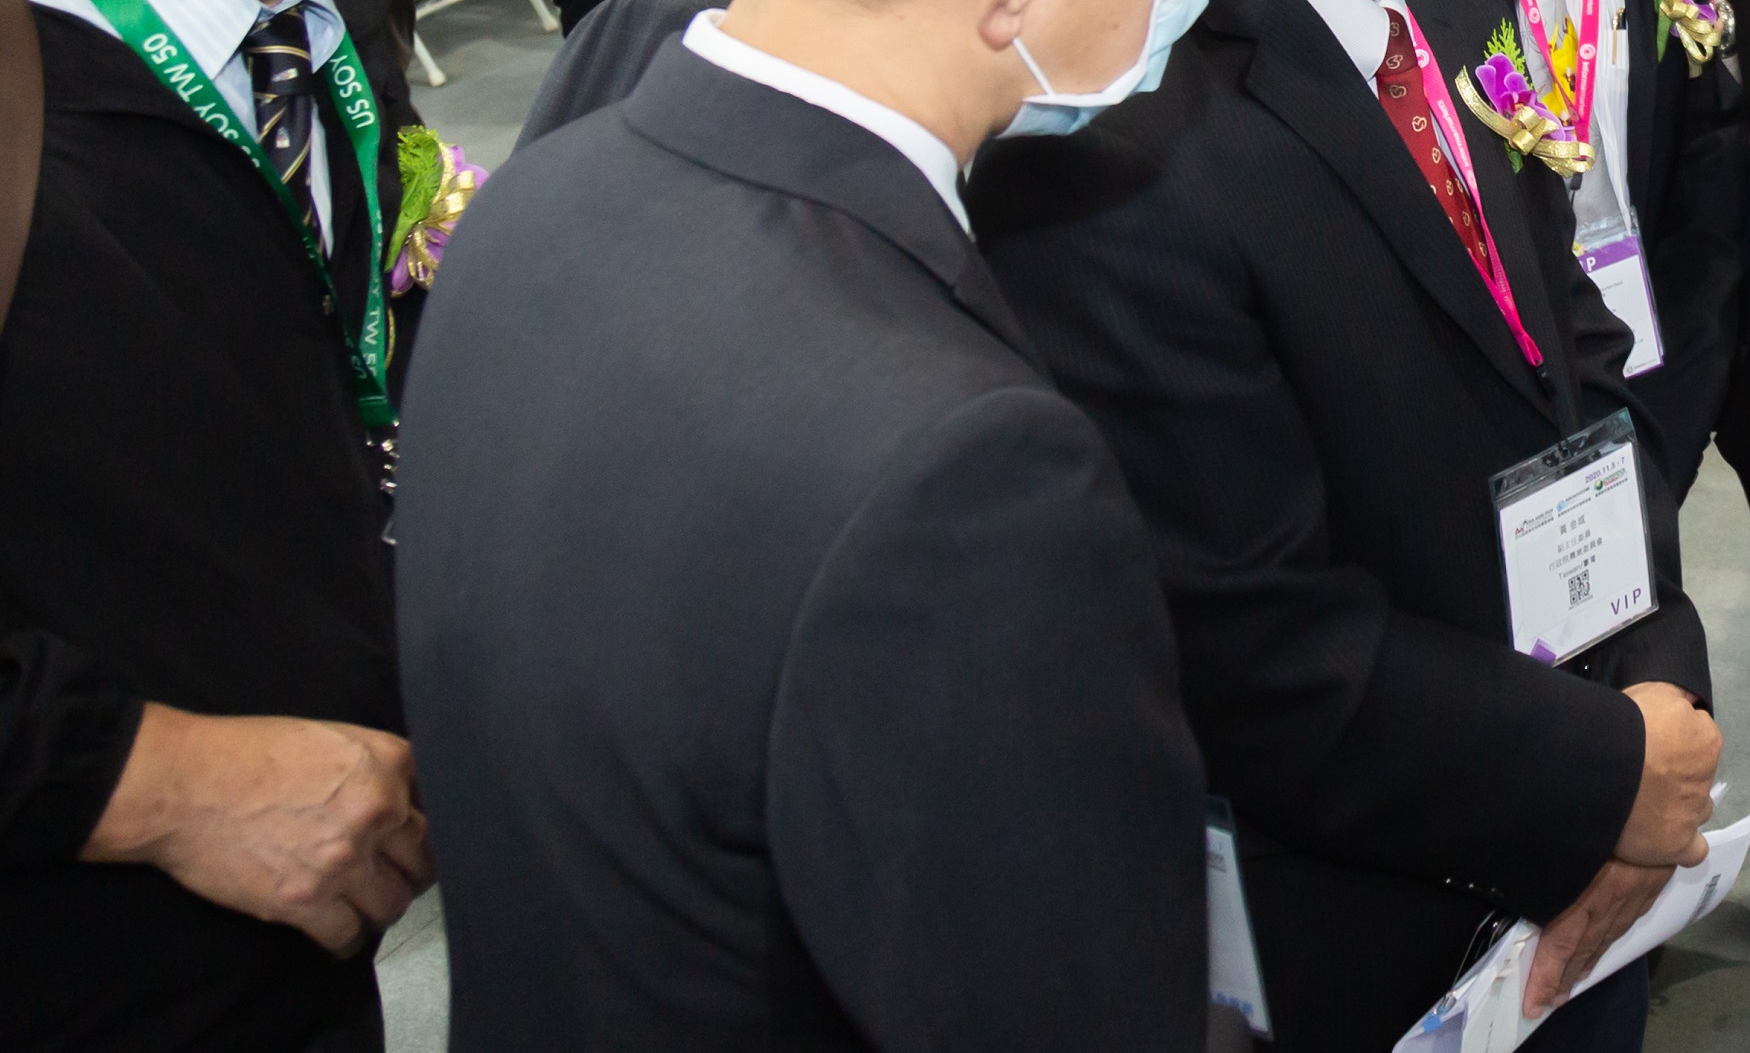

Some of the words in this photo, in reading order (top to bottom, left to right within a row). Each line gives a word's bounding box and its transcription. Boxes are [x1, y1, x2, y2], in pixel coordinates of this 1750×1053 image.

[142, 33, 178, 65] 50
[163, 63, 203, 103] TW
[329, 55, 362, 98] SOY
[346, 99, 375, 129] US
[364, 306, 380, 345] TW
[1610, 587, 1642, 615] VIP
